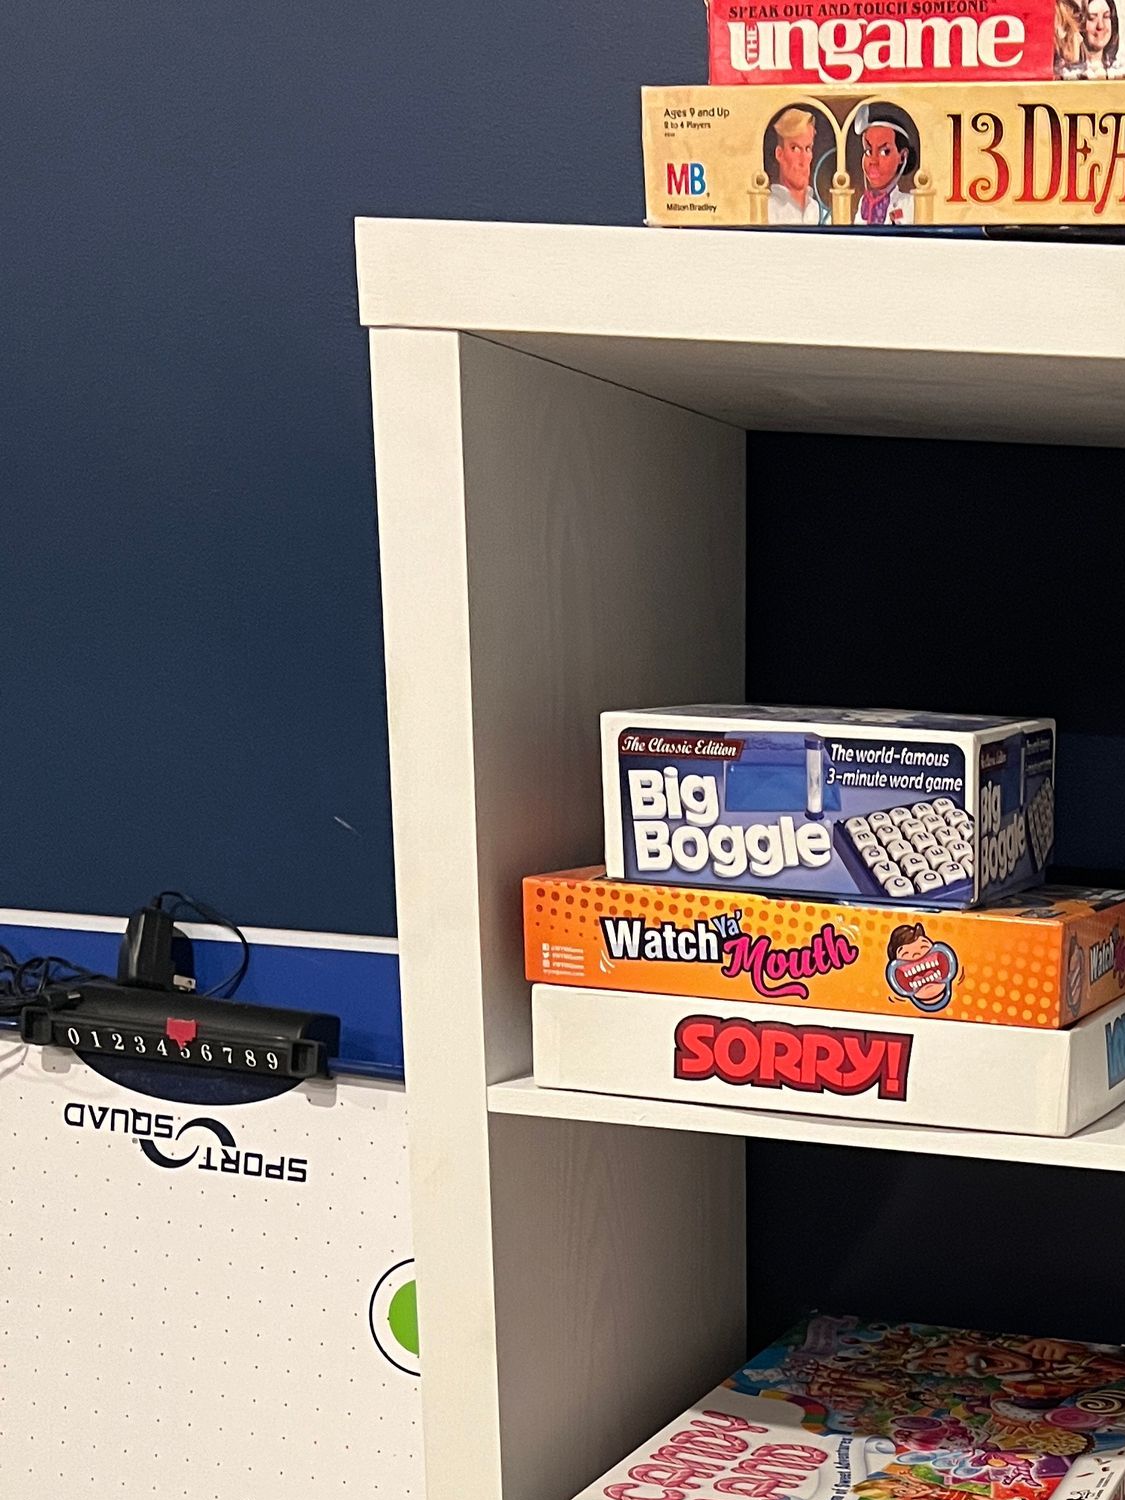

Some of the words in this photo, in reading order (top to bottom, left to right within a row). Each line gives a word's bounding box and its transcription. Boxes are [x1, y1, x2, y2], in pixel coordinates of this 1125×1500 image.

[729, 5, 777, 19] SPEAK
[783, 4, 815, 17] OUT
[818, 3, 850, 16] AND
[855, 2, 904, 15] TOUCH
[911, 0, 988, 14] SOMEONE
[727, 15, 1025, 84] ungame
[663, 108, 687, 119] Ages
[697, 108, 715, 118] and
[716, 107, 730, 118] Up
[686, 121, 712, 130] Players
[944, 112, 1011, 204] 13
[667, 163, 706, 196] MB
[666, 203, 689, 212] Milton
[689, 203, 717, 213] Bradley
[621, 736, 647, 753] The
[648, 737, 694, 755] Classic
[694, 739, 738, 757] Edition
[831, 743, 855, 763] The
[856, 746, 950, 768] world-famous
[627, 766, 720, 828] Big
[827, 767, 888, 788] 3-minute
[888, 770, 922, 791] word
[923, 776, 963, 793] game
[981, 780, 1001, 836] Big
[632, 815, 832, 878] Boggle
[602, 917, 721, 962] Watch
[713, 910, 742, 938] Ya'
[722, 922, 860, 998] Mouth
[66, 1026, 81, 1047] 0
[90, 1030, 103, 1049] 1
[110, 1032, 126, 1052] 2
[133, 1034, 147, 1055] 3
[156, 1038, 169, 1057] 4
[200, 1043, 213, 1062] 6
[221, 1046, 234, 1064] 7
[244, 1049, 257, 1068] 8
[266, 1051, 279, 1070] 9
[676, 1016, 910, 1098] SORRY!
[63, 1101, 175, 1140] SQUAD
[198, 1145, 309, 1183] SPORT
